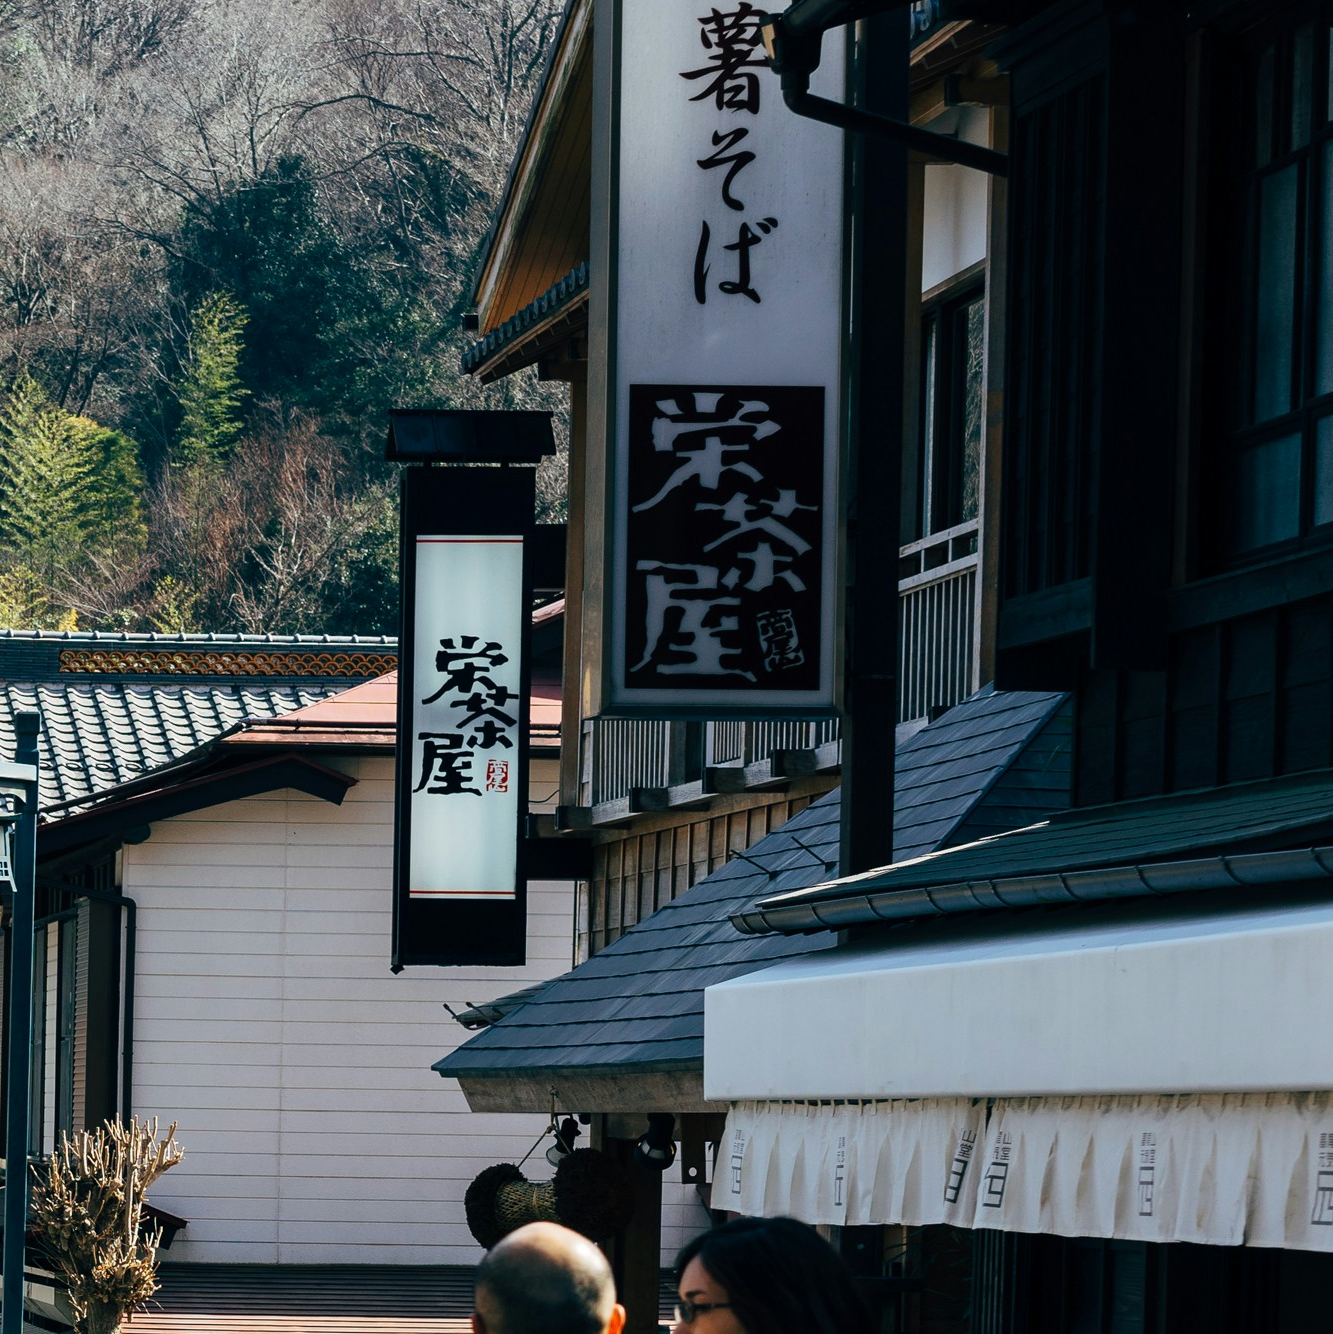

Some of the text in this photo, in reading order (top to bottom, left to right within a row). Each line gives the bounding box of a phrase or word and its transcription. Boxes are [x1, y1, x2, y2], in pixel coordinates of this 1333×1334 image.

[630, 391, 818, 684] 栄茶屋
[412, 635, 520, 797] 栄茶屋
